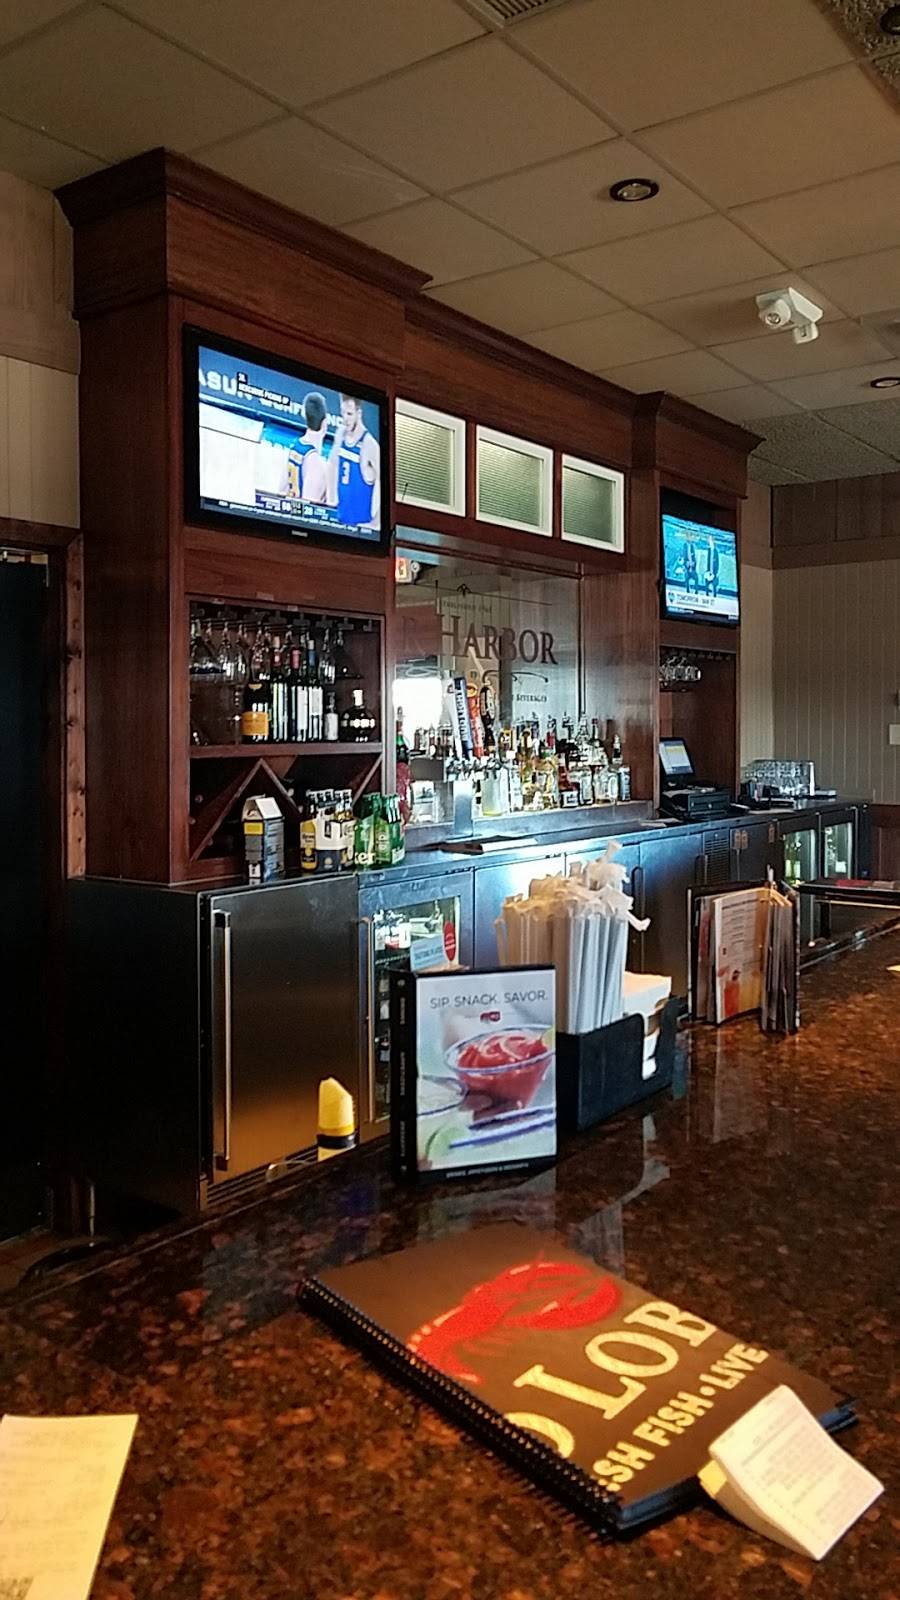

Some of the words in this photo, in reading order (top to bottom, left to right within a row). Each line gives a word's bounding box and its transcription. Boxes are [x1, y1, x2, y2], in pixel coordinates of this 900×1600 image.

[342, 461, 351, 485] 3
[435, 613, 559, 665] HARBOR
[504, 989, 548, 1004] SAVOR.
[513, 1301, 718, 1420] LOB
[593, 1441, 656, 1492] SH
[633, 1391, 714, 1447] FISH
[699, 1342, 769, 1390] LIVE
